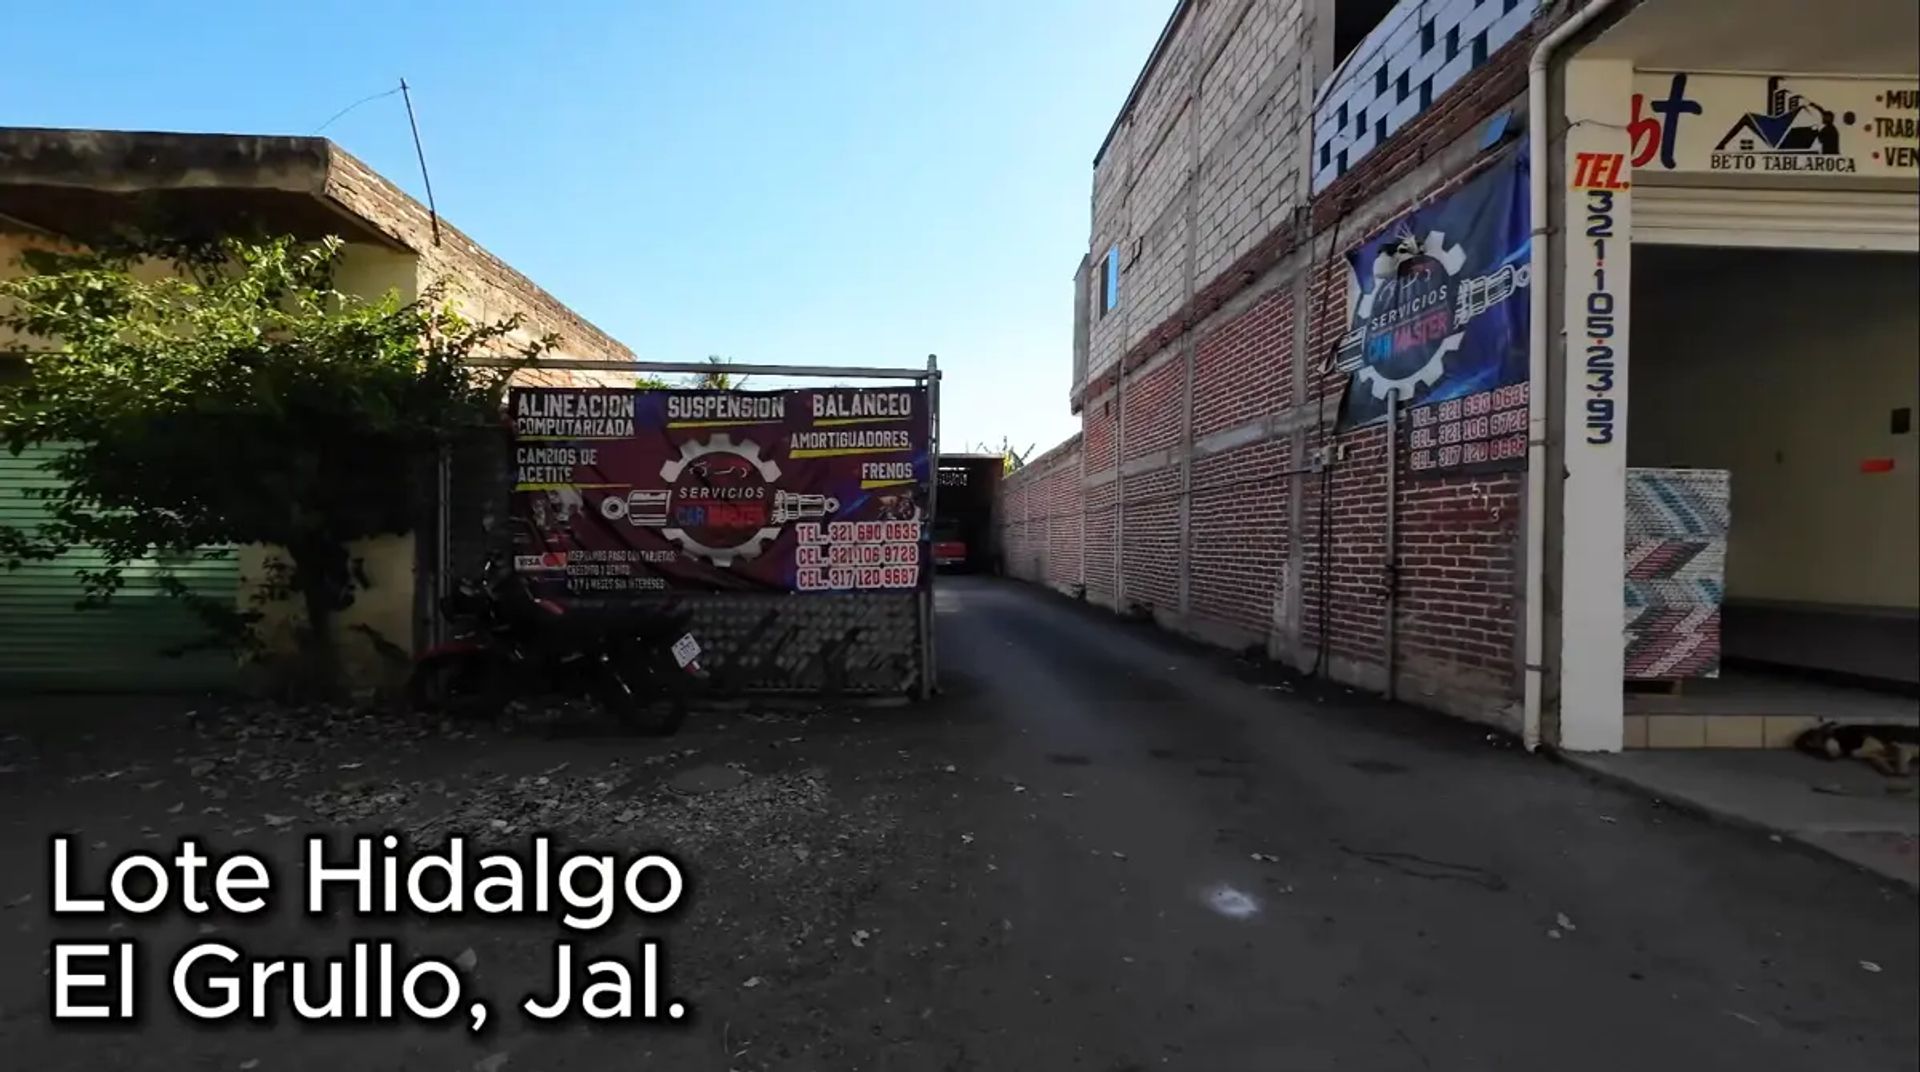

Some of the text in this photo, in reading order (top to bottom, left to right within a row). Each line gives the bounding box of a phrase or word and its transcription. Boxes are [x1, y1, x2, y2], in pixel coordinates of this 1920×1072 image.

[1874, 117, 1919, 138] TRAB
[1574, 152, 1630, 190] TEL.
[1711, 154, 1857, 173] BETO TABLAROCA
[1371, 284, 1449, 331] SERVICIOS
[518, 393, 635, 418] ALINEACION
[667, 395, 785, 418] SUSPENSION
[812, 393, 911, 417] BALANCEO
[517, 417, 635, 436] COMPUTARIZADA
[517, 448, 598, 465] CAMBIOS DE
[862, 462, 913, 479] FRENOS
[680, 486, 765, 499] SERVICIOS
[798, 523, 918, 542] TEL. 321 690 0635
[799, 545, 916, 565] CEL. 321 106 9728
[799, 568, 916, 587] CEL. 317 120 9687
